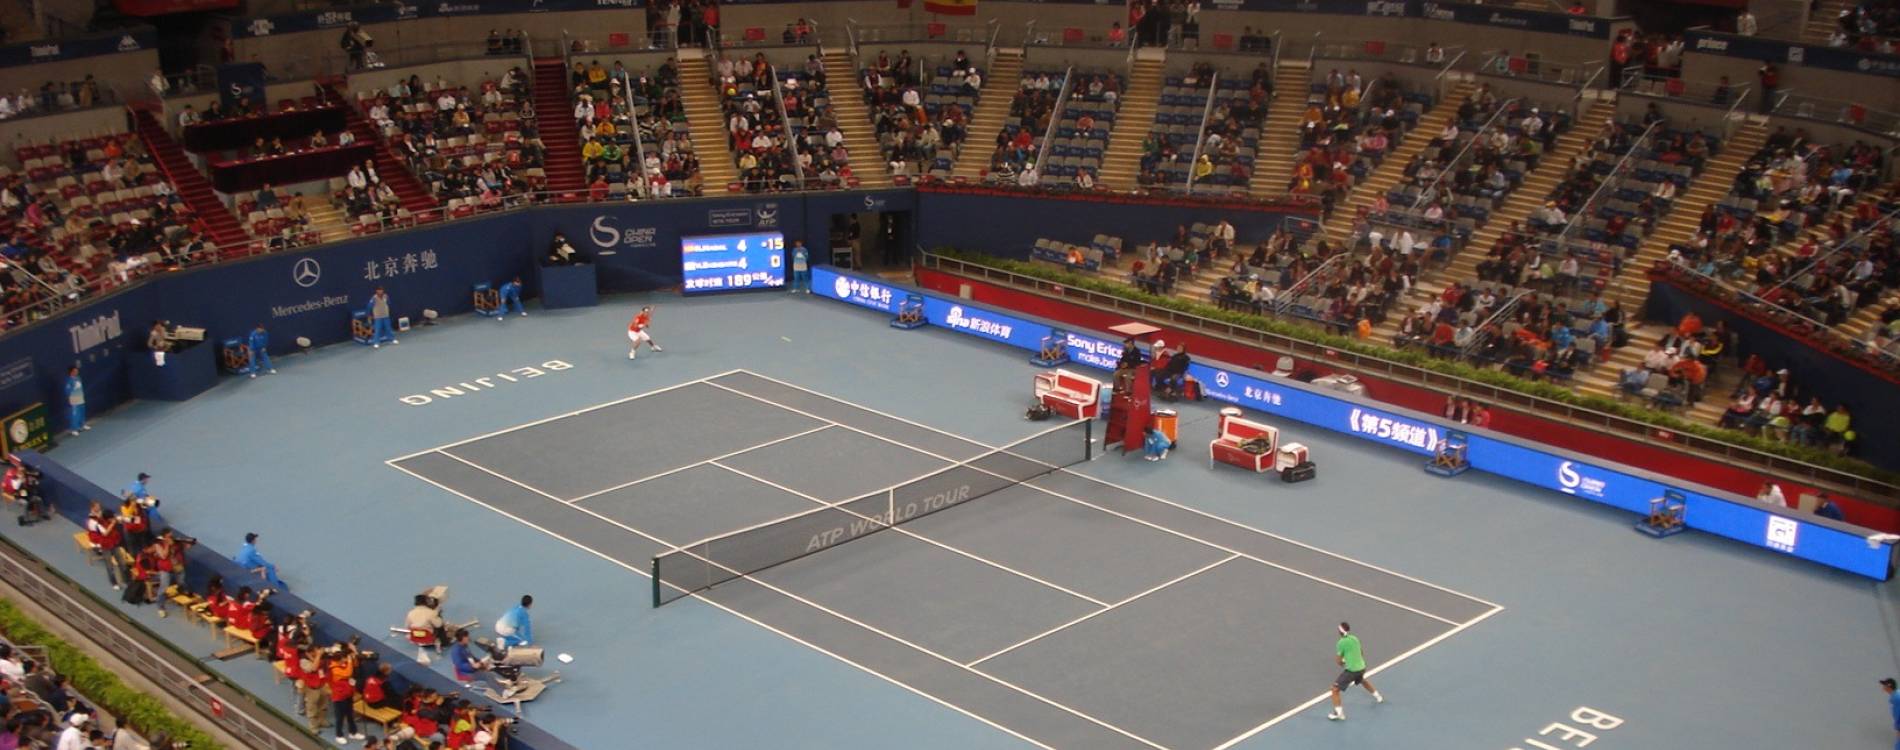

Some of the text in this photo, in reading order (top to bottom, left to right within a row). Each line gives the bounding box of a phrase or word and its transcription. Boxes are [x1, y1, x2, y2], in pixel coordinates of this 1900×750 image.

[736, 239, 748, 253] 4
[363, 249, 439, 282] 北京奔驰
[737, 257, 748, 270] 4
[770, 254, 781, 269] 0
[727, 273, 752, 288] 189
[271, 294, 349, 319] Mercedes-Benz
[1066, 333, 1096, 354] Sony
[399, 359, 575, 406] BEIJING
[805, 484, 971, 552] ATP WORLD TOUR
[1508, 706, 1625, 750] BEI
